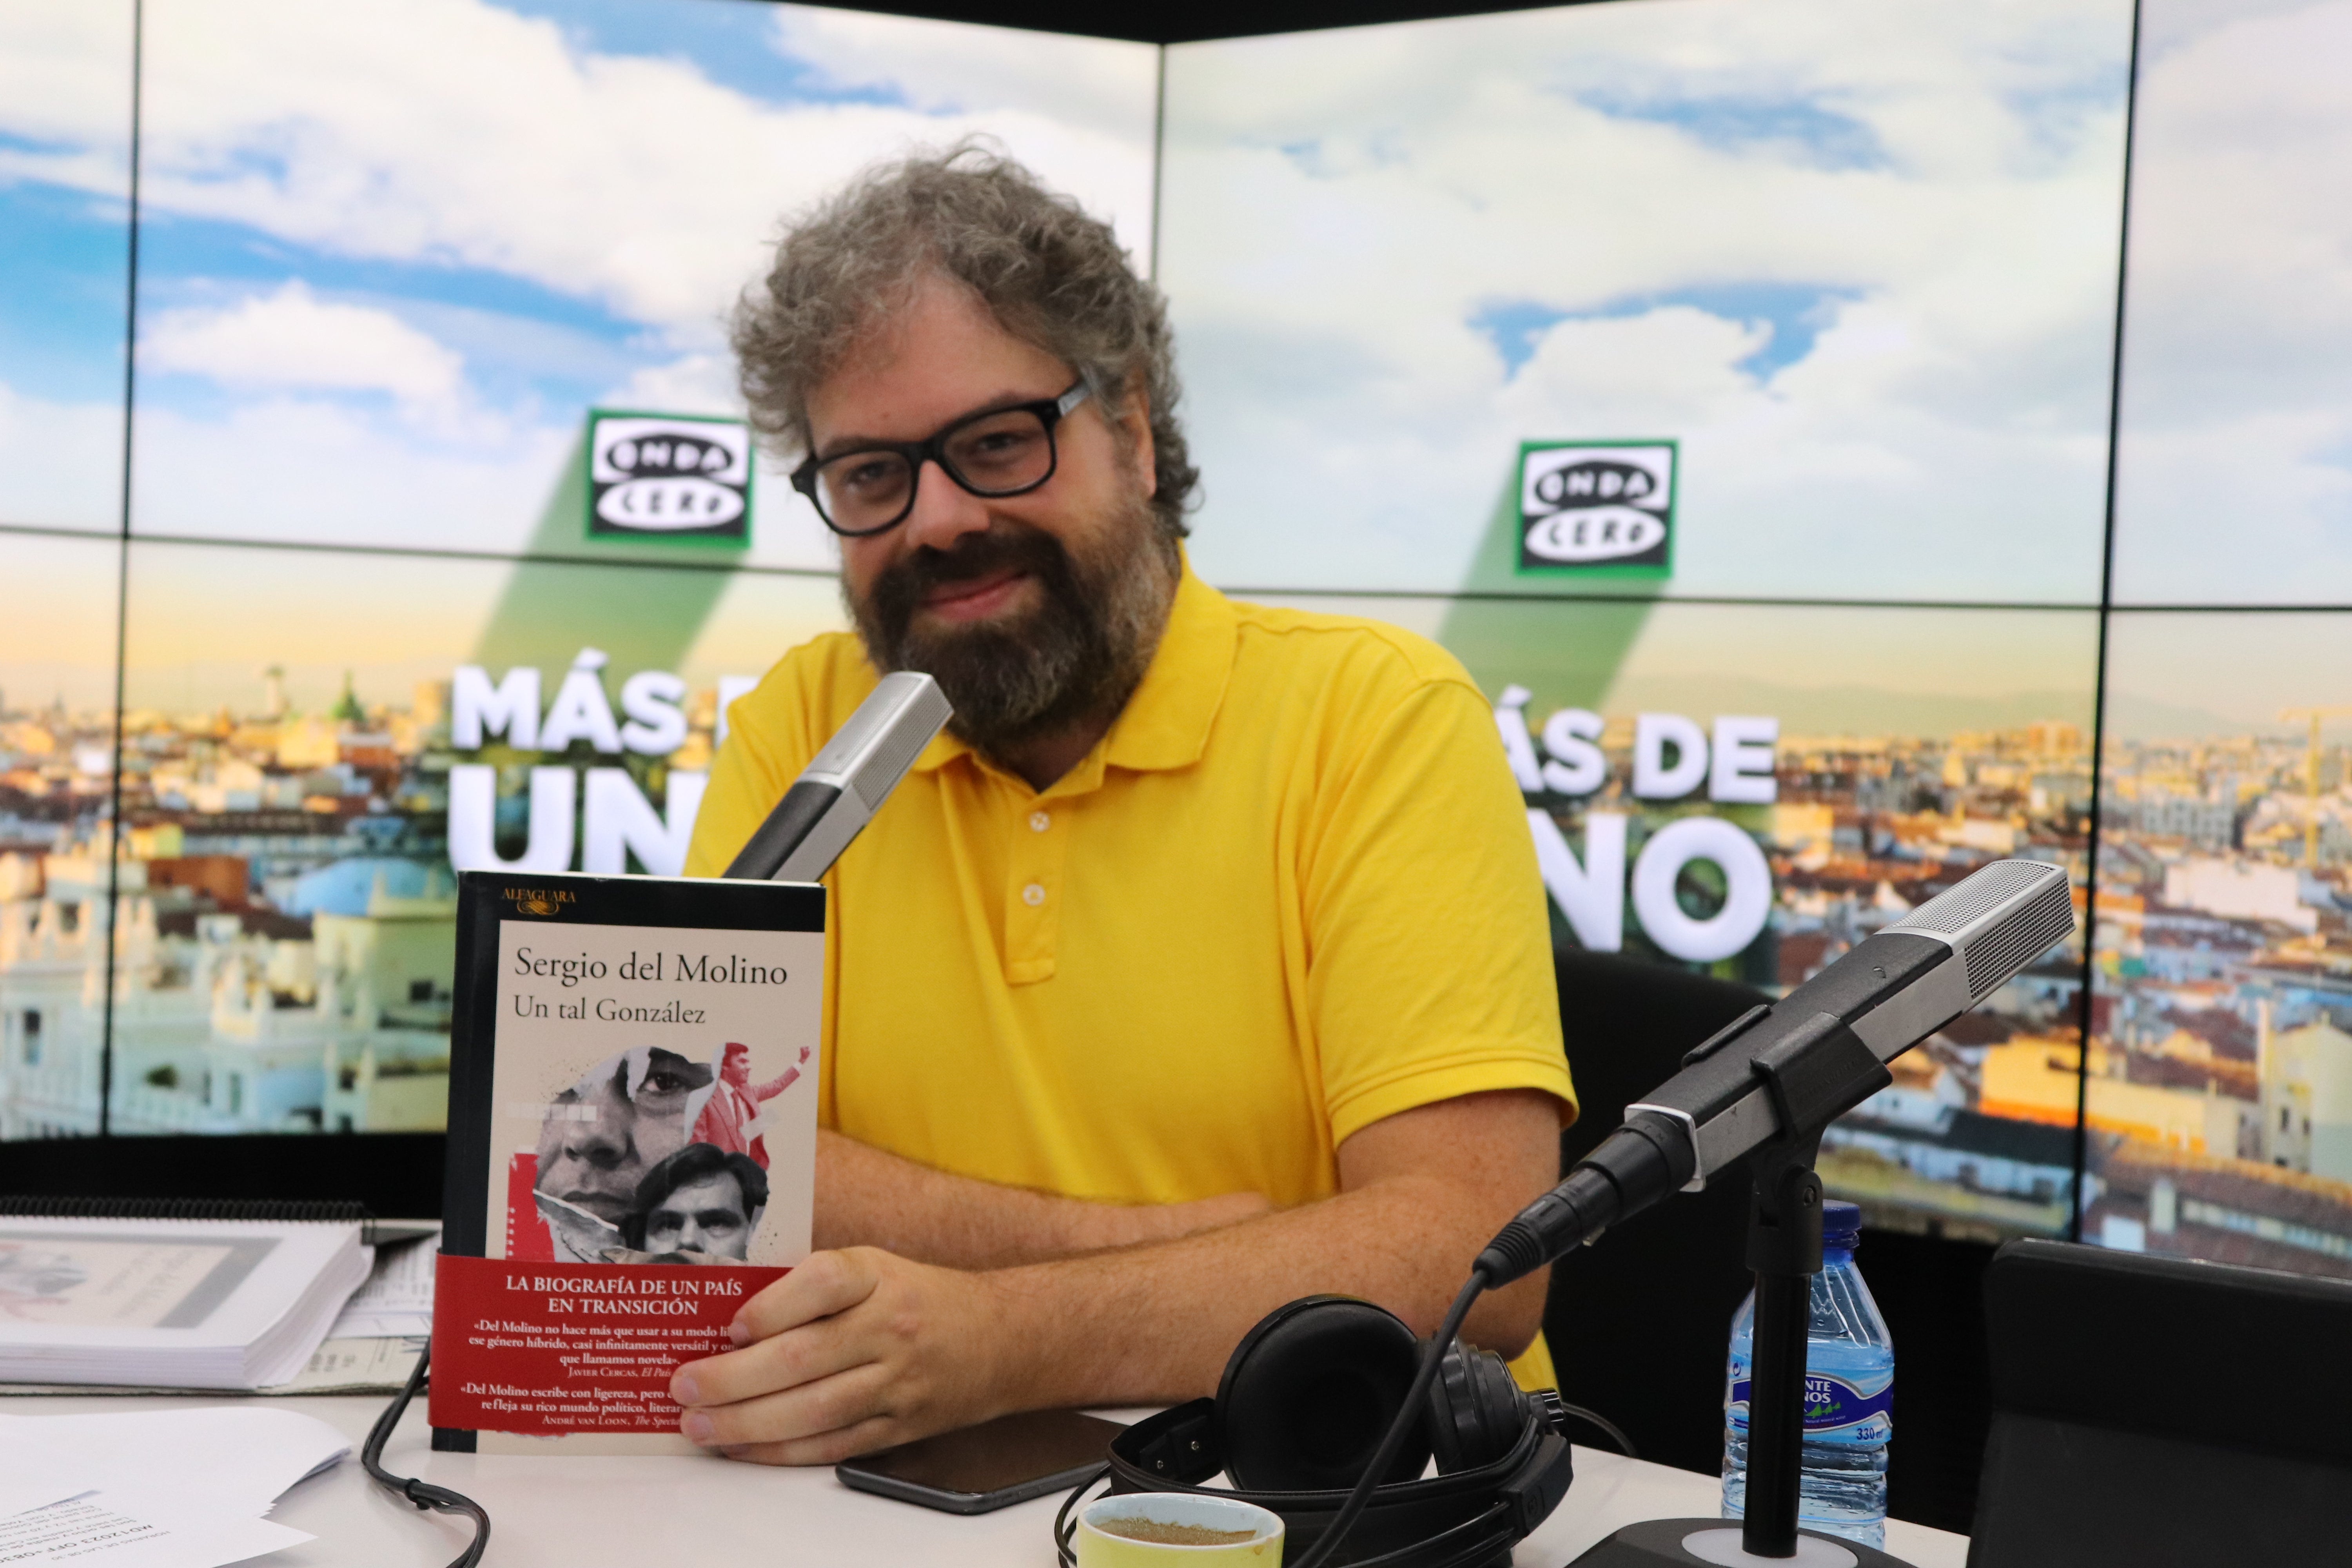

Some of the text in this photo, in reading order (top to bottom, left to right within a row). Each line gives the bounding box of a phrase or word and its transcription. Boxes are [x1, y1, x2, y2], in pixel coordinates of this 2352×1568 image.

[613, 437, 728, 472] ONDA
[1539, 468, 1649, 501] ONDA
[452, 646, 688, 755] MÁS
[1496, 683, 1779, 804] ÁS DE
[448, 764, 708, 876] UN
[1526, 808, 1773, 963] NO
[502, 888, 576, 903] ALFAGUARA
[514, 947, 788, 987] Sergio del Molino
[514, 995, 705, 1024] Un tal González
[506, 1275, 743, 1296] LA BIOGRAFÍA DE UN PAÍS
[548, 1298, 698, 1315] EN TRANSICIÓN
[474, 1319, 499, 1331] «Del
[503, 1321, 542, 1334] Molino
[563, 1323, 586, 1335] hace
[589, 1325, 611, 1335] más
[614, 1328, 633, 1339] que
[637, 1328, 660, 1336] usar
[671, 1328, 683, 1337] su
[686, 1325, 717, 1337] modo
[720, 1326, 728, 1337] li
[469, 1337, 485, 1345] ese
[487, 1335, 524, 1349] género
[527, 1336, 570, 1349] híbrido,
[573, 1339, 593, 1349] casi
[596, 1339, 669, 1350] infinitamente
[671, 1340, 709, 1351] versátil
[711, 1344, 719, 1354] y
[559, 1353, 681, 1367] que llamamos novela».
[641, 1367, 652, 1377] El
[653, 1368, 671, 1377] País
[461, 1383, 486, 1394] «Del
[489, 1384, 529, 1396] Molino
[532, 1387, 568, 1397] escribe
[571, 1389, 592, 1398] con
[594, 1387, 638, 1401] ligereza,
[640, 1390, 664, 1401] pero
[1805, 1379, 1832, 1392] NTE
[481, 1399, 683, 1415] refleja su rico mundo político, literar
[635, 1416, 649, 1425] The
[1856, 1427, 1875, 1440] 330
